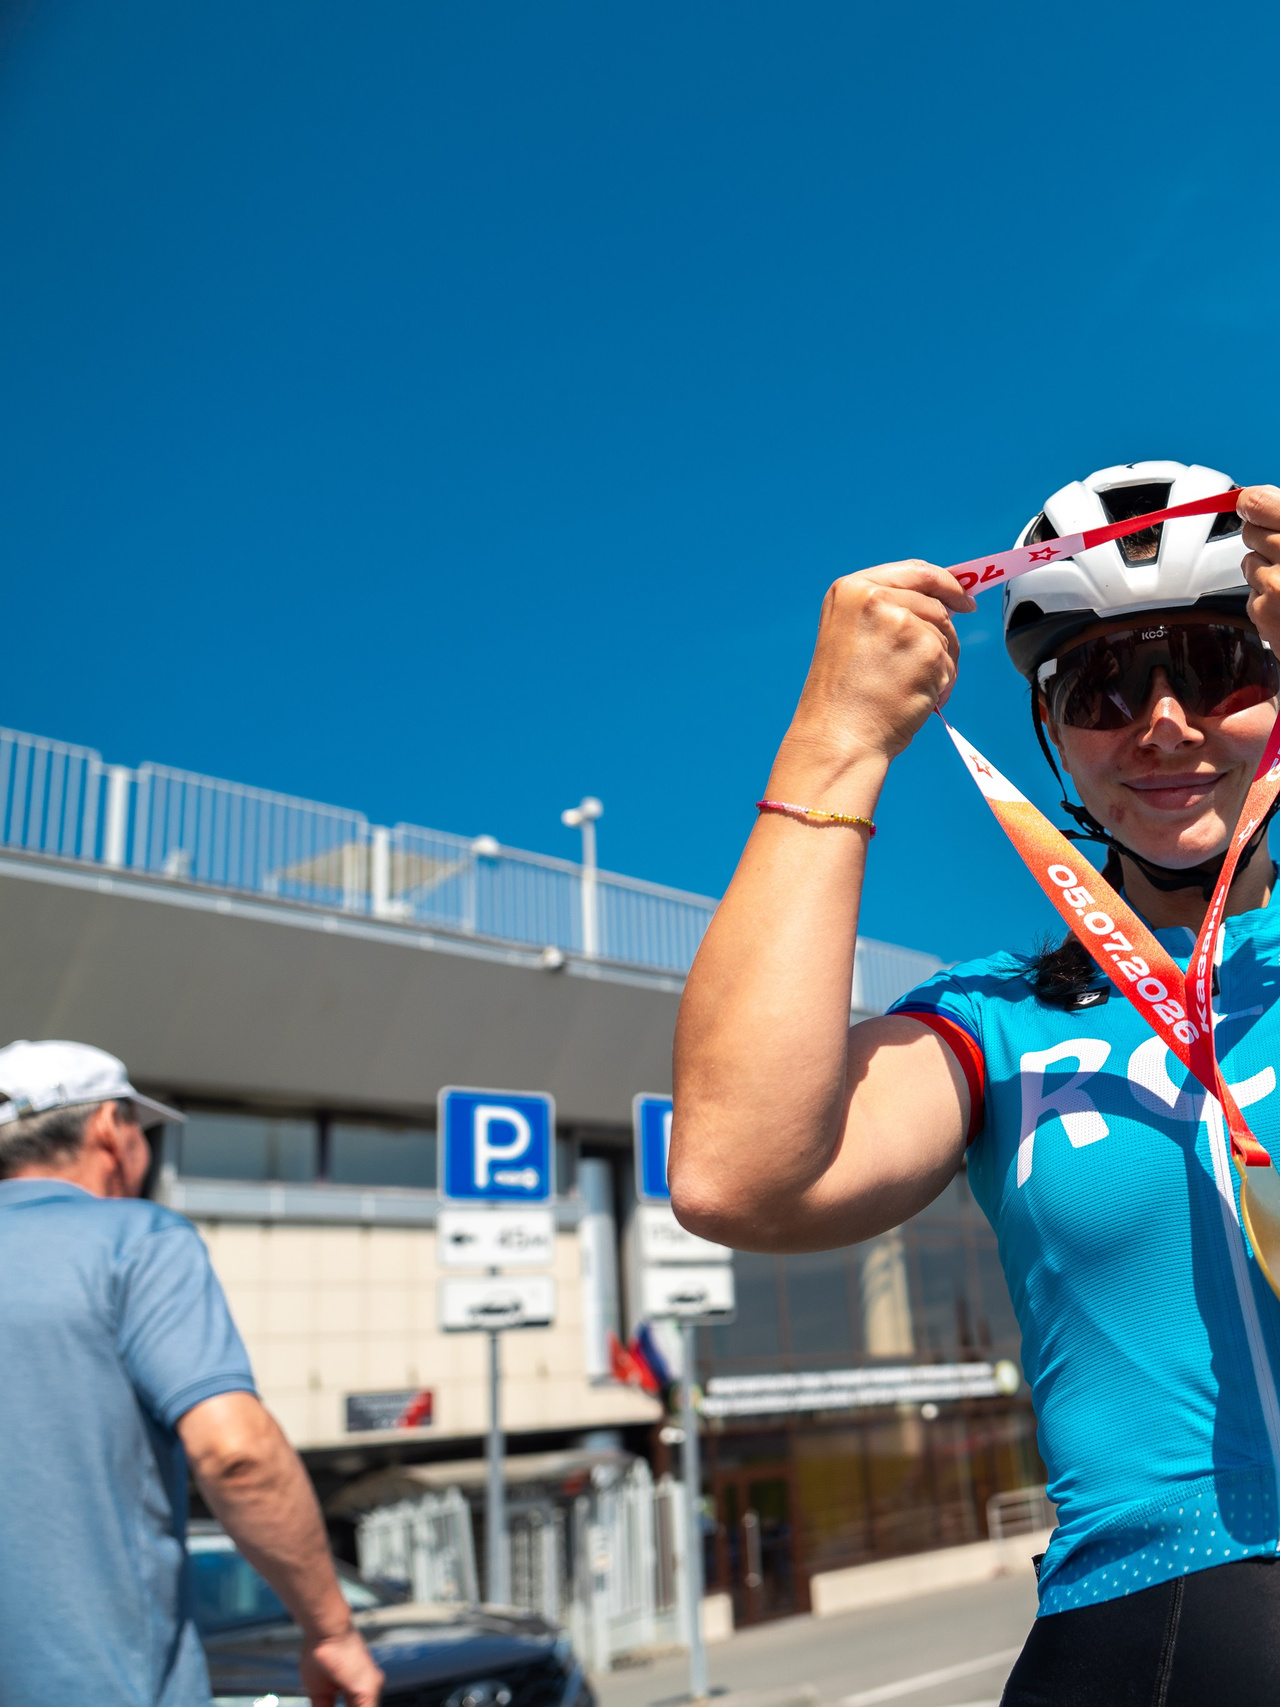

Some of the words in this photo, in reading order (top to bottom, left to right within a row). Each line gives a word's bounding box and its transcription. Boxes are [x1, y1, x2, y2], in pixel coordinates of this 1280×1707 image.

[1047, 864, 1200, 1045] 05.07.2026
[1196, 884, 1226, 1034] Казань
[473, 1105, 532, 1189] P
